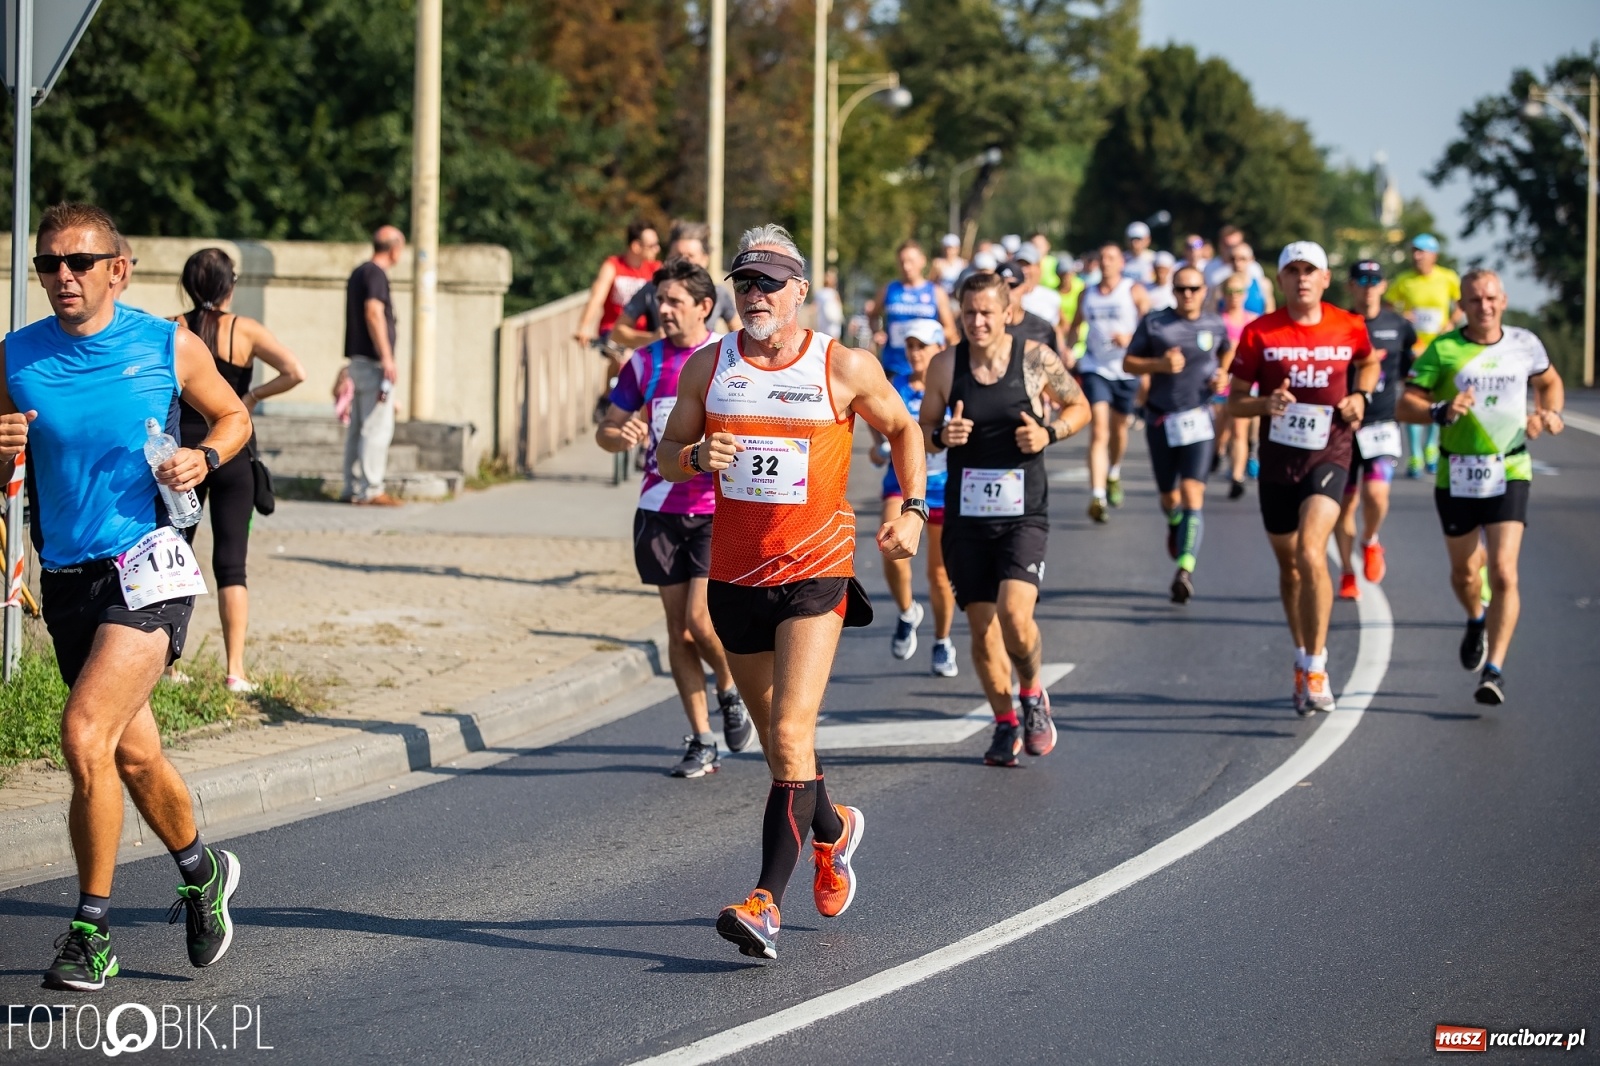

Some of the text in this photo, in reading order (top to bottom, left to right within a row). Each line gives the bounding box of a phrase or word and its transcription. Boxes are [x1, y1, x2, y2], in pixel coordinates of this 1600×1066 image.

[122, 365, 141, 376] 4F
[727, 381, 748, 389] PGE
[767, 389, 823, 403] FENIKS
[1288, 415, 1316, 431] 284
[751, 454, 779, 476] 32
[1466, 467, 1492, 481] 300
[983, 483, 1002, 498] 47
[147, 545, 185, 572] 106
